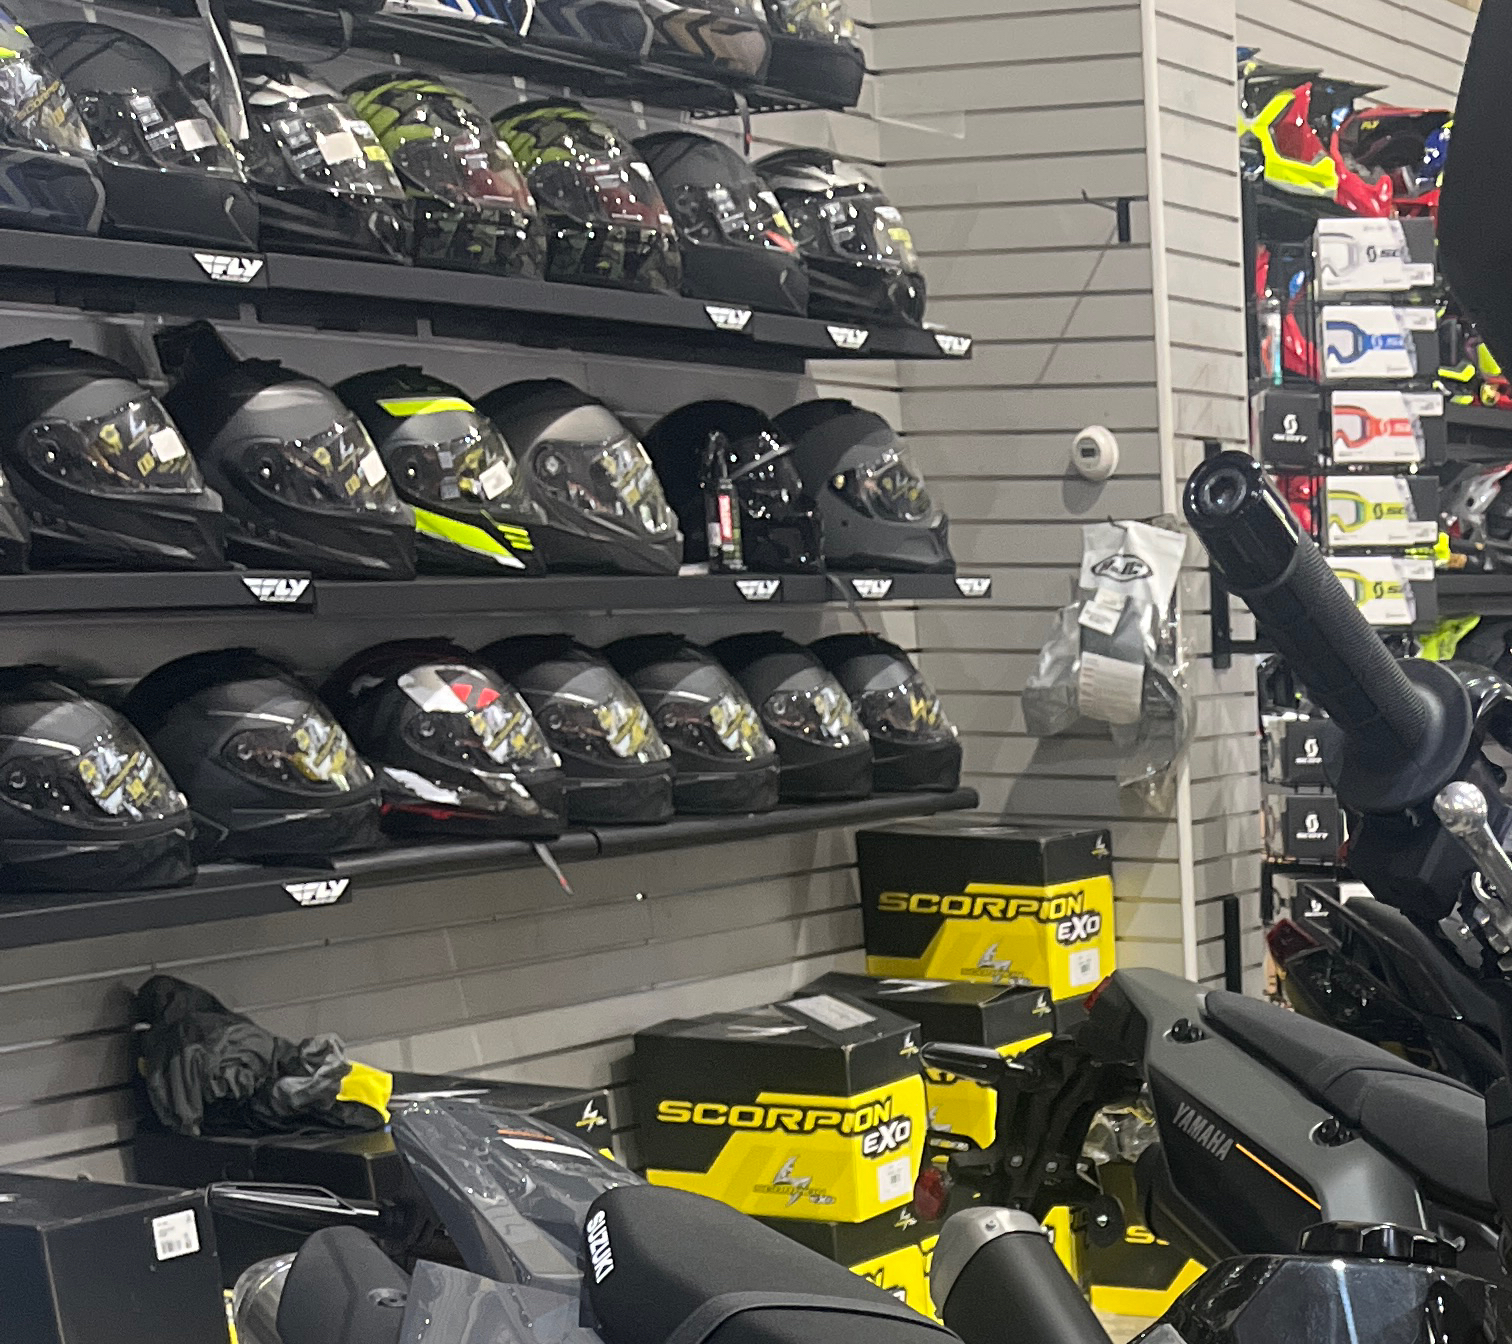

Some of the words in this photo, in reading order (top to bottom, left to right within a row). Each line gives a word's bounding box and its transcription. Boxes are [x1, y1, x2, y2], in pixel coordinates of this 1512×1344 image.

[194, 253, 264, 277] FLY
[242, 578, 311, 597] FLY
[285, 878, 350, 902] FLY
[878, 890, 1085, 921] SCORPION
[656, 1094, 893, 1133] SCORPION
[1173, 1102, 1234, 1161] YAMAHA
[587, 1210, 614, 1284] SUZUKI
